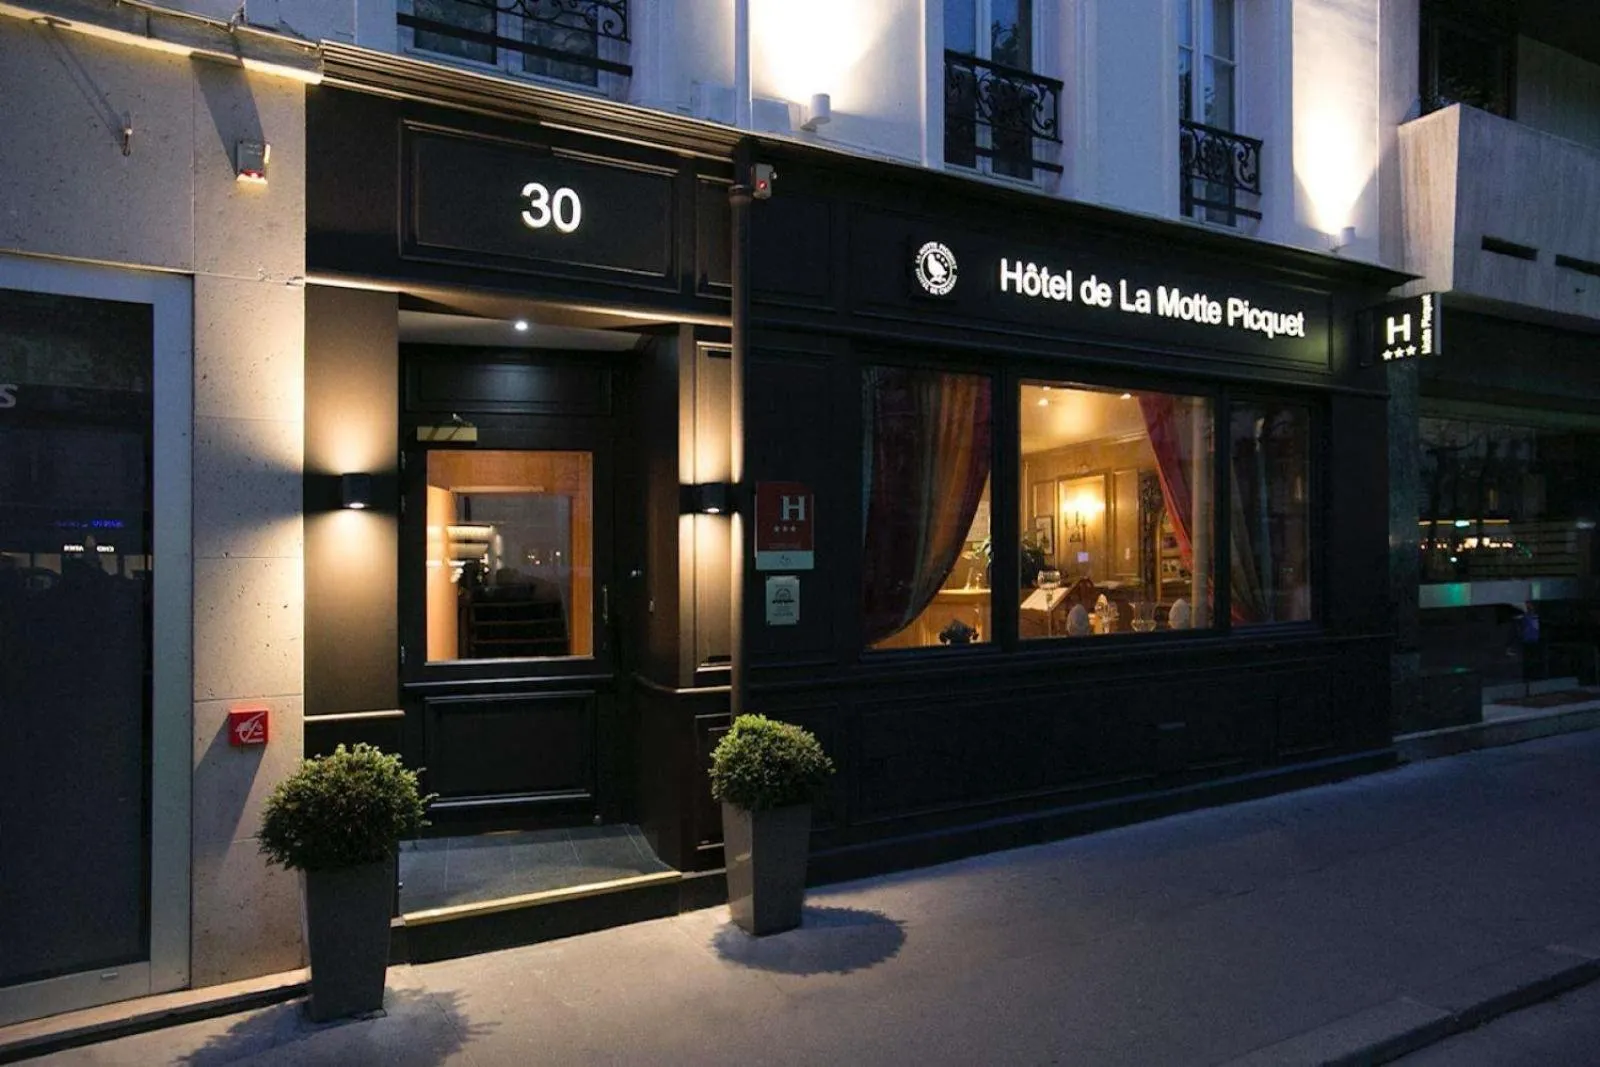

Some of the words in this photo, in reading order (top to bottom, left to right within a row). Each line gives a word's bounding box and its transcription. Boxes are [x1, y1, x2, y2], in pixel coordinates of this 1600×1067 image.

[522, 183, 581, 232] 30
[1001, 258, 1072, 301] Hôtel
[1080, 275, 1112, 307] de
[1120, 279, 1151, 314] La
[1157, 286, 1222, 324] Motte
[1227, 297, 1305, 339] Picquet
[1387, 314, 1411, 345] H
[782, 495, 805, 520] H
